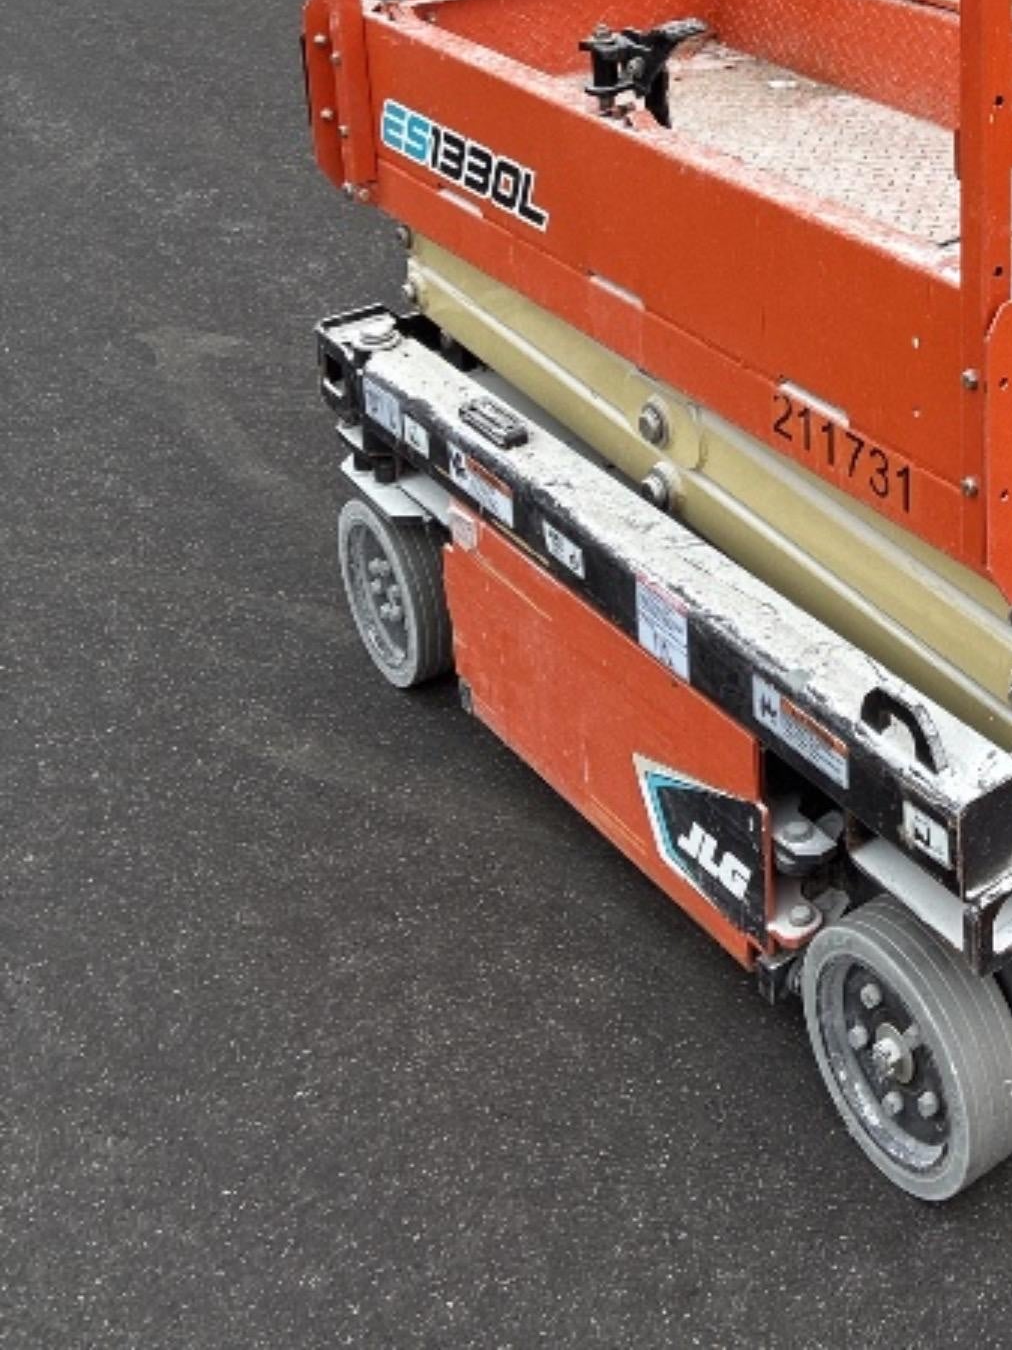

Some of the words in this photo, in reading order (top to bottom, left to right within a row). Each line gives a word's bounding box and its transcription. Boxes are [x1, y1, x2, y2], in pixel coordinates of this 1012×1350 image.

[382, 98, 549, 231] ES1330L
[773, 393, 910, 513] 211731
[677, 821, 752, 901] JLG
